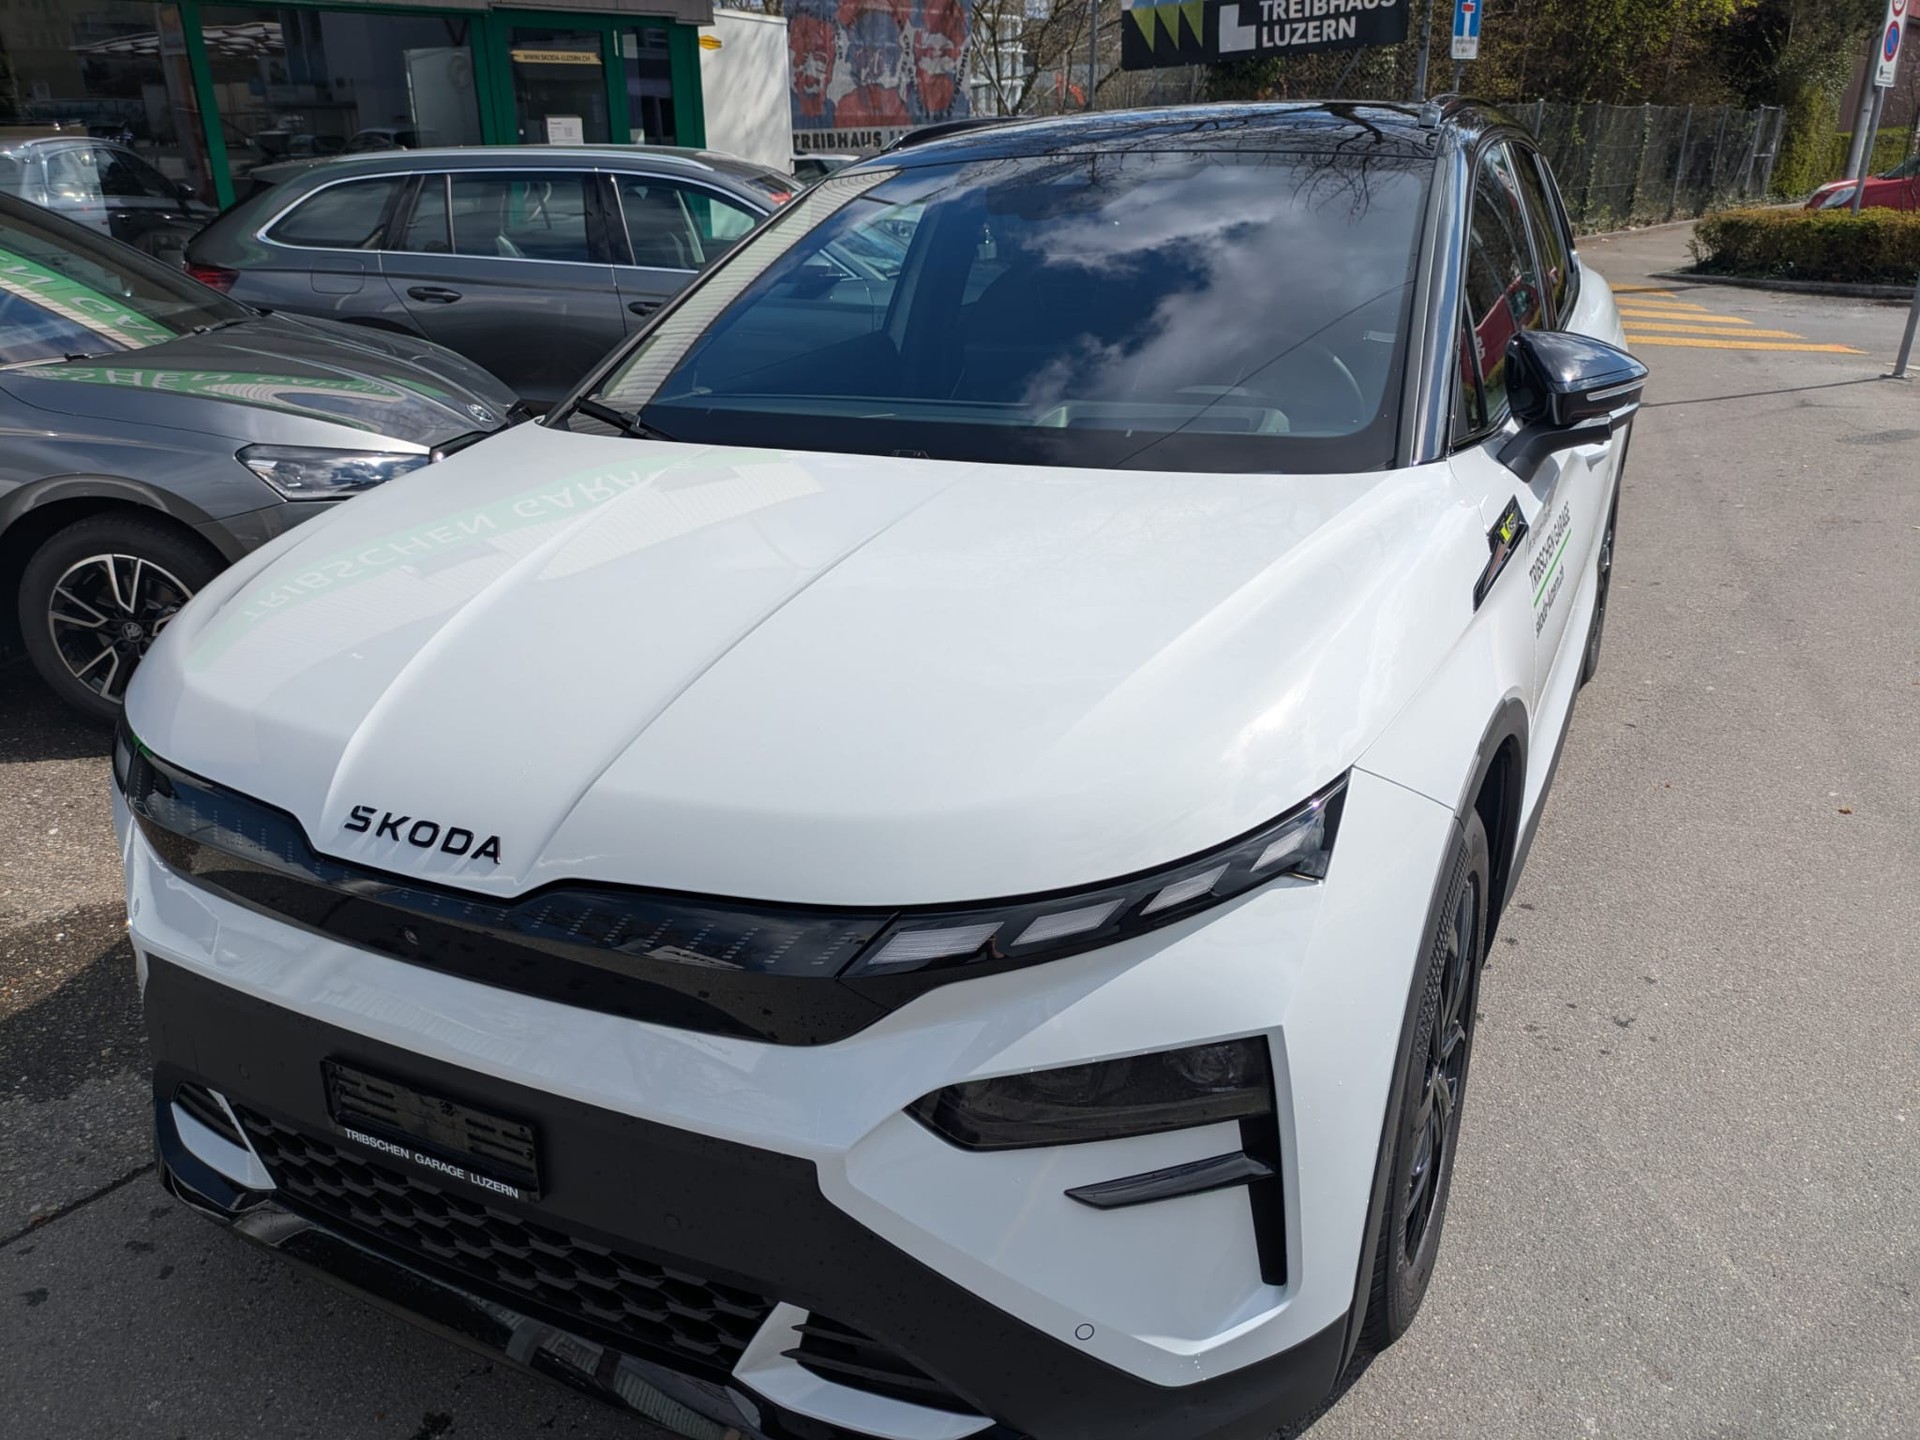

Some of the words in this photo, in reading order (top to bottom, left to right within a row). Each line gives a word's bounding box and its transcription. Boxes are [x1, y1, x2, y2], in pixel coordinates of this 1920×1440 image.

[1261, 16, 1357, 48] LUZERN
[793, 131, 882, 151] TREIBHAUS
[344, 1127, 410, 1160] TRIBSCHEN
[414, 1153, 466, 1180] GARAGE
[470, 1172, 520, 1199] LUZERN
